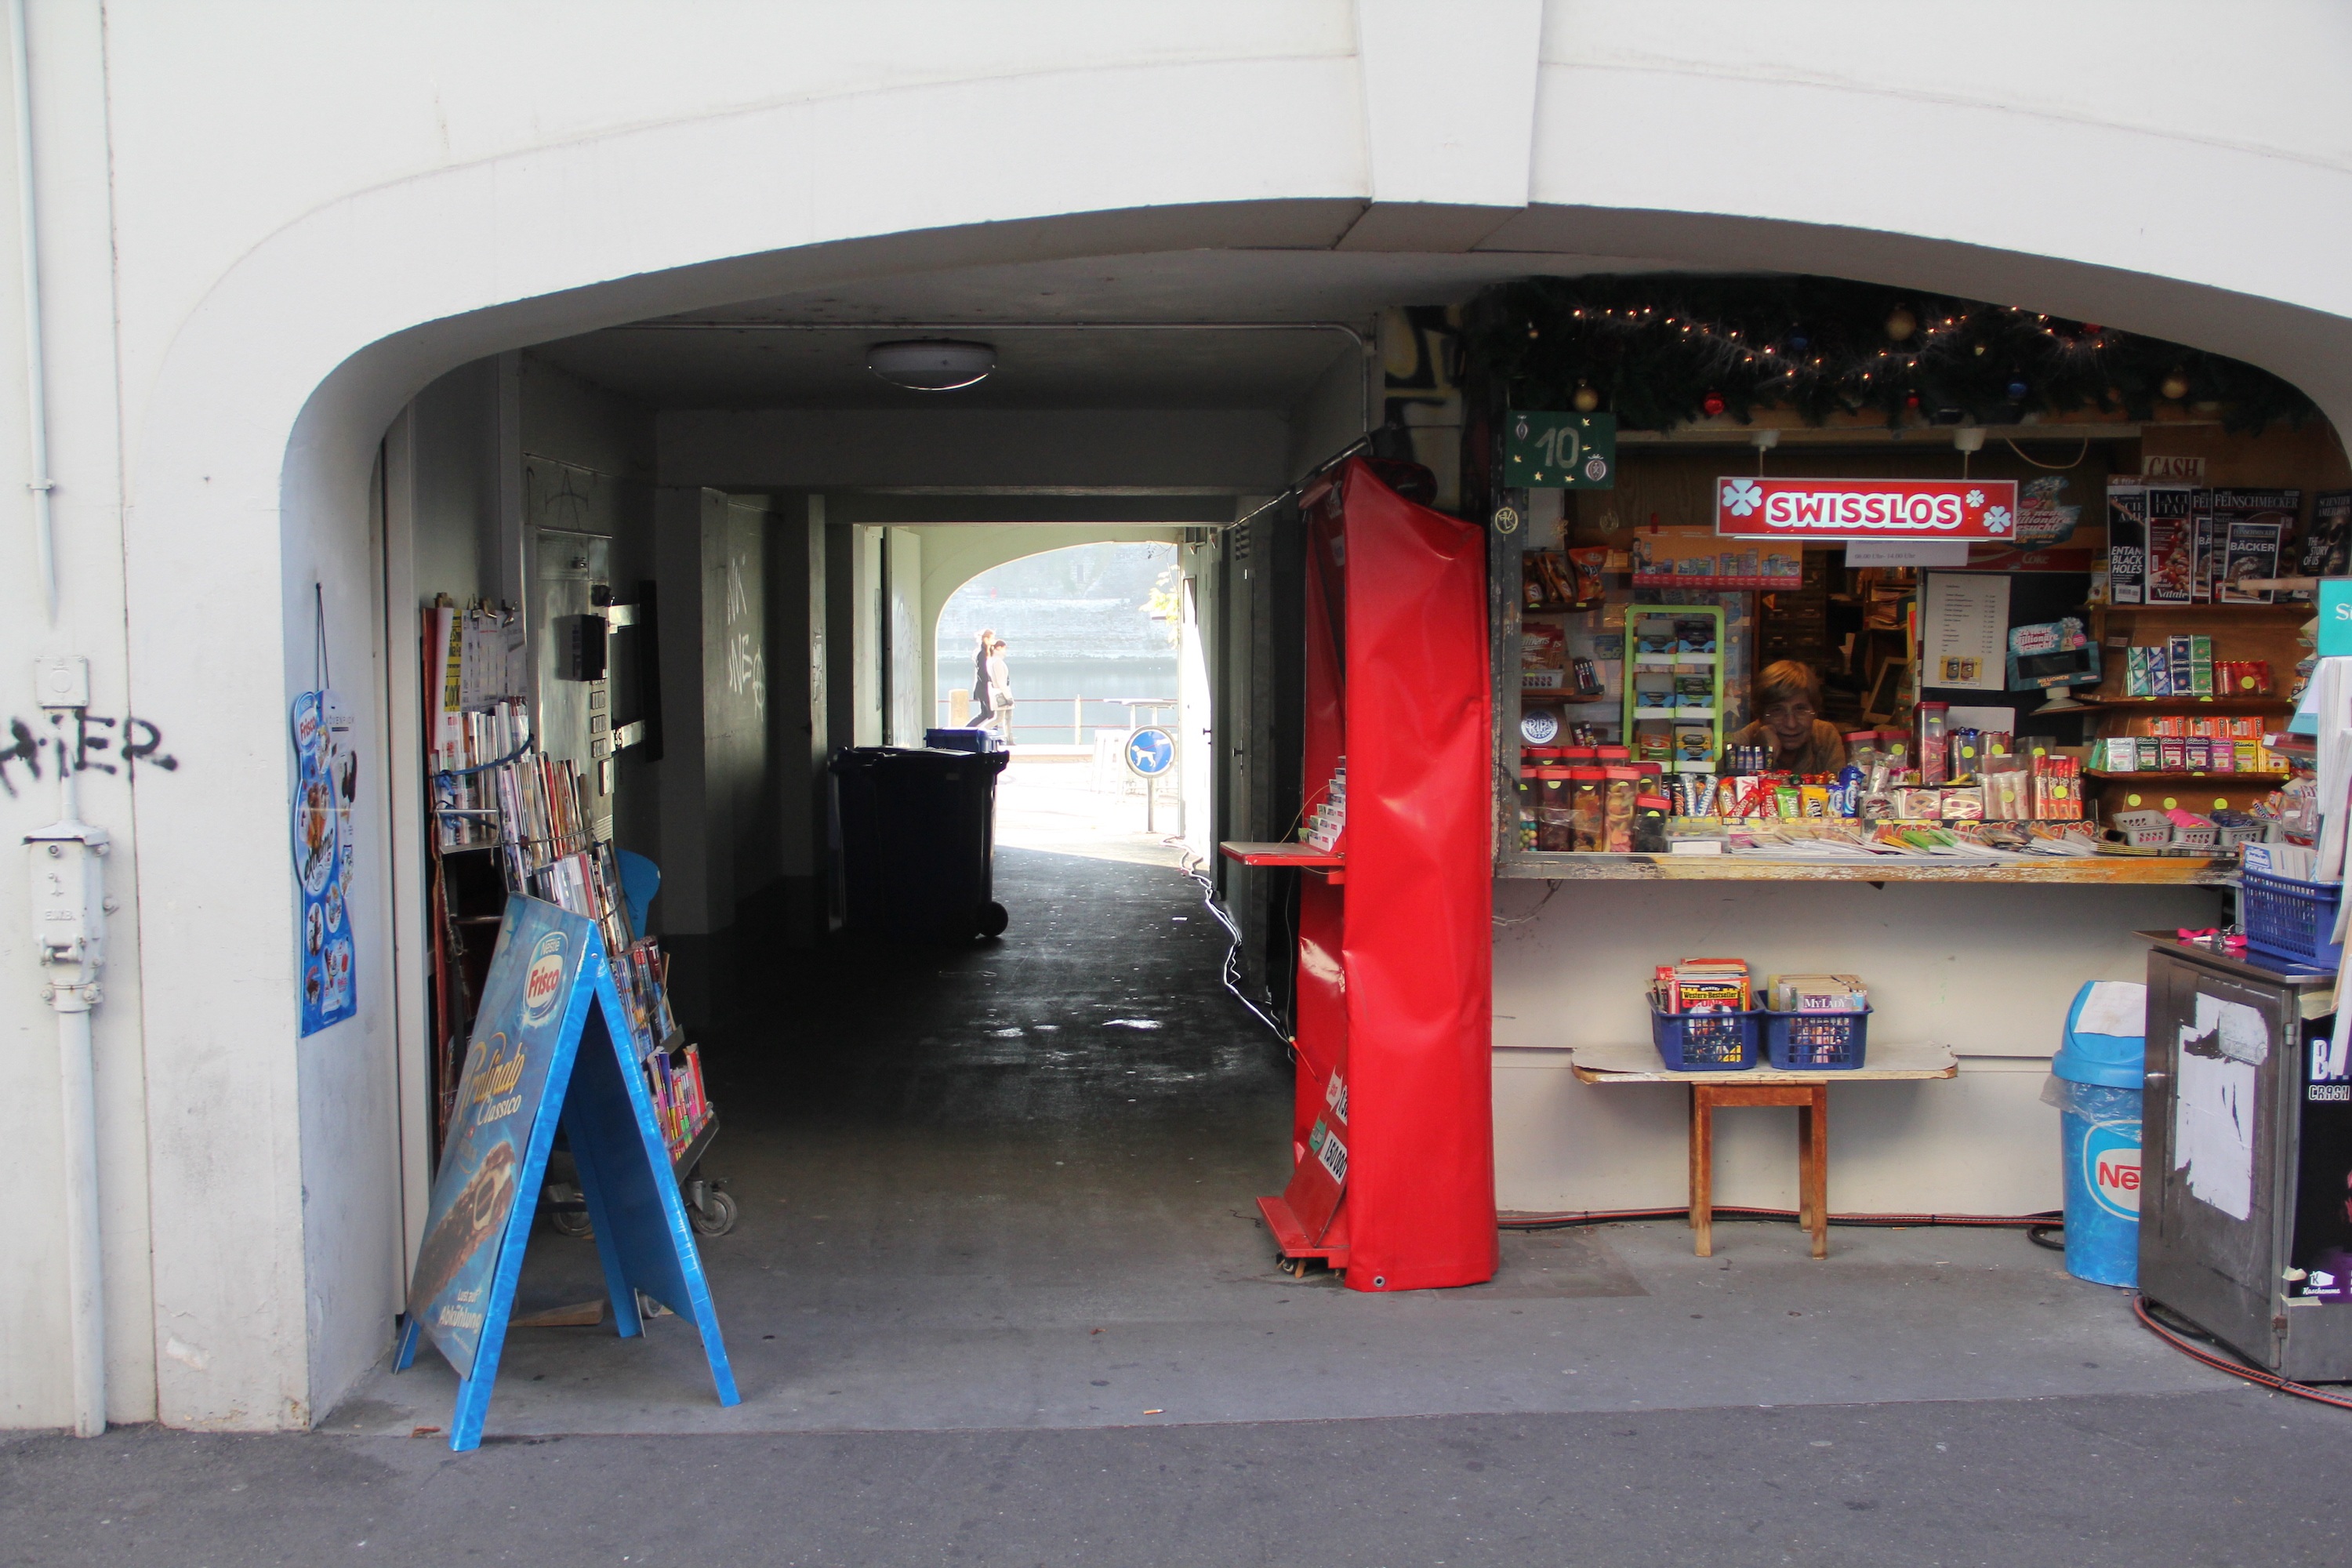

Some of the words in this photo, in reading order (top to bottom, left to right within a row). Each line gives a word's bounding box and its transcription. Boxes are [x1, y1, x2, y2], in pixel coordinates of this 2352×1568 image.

[1535, 427, 1579, 469] 10
[2147, 456, 2200, 476] CASH
[2214, 493, 2298, 508] FEINSCHMECKER
[1766, 493, 1961, 528] SWISSLOS
[2230, 540, 2276, 552] BÄCKER
[2307, 537, 2318, 546] THE
[2310, 546, 2329, 556] STORY
[2111, 555, 2143, 564] BLACK
[2303, 556, 2311, 566] OF
[2311, 555, 2320, 565] US
[2111, 564, 2143, 574] HOLES
[528, 966, 560, 999] Frisco
[2308, 1084, 2350, 1101] CRASH
[477, 1094, 522, 1127] Classico
[2099, 1161, 2141, 1190] Ne
[2302, 1287, 2341, 1295] Kaschemme
